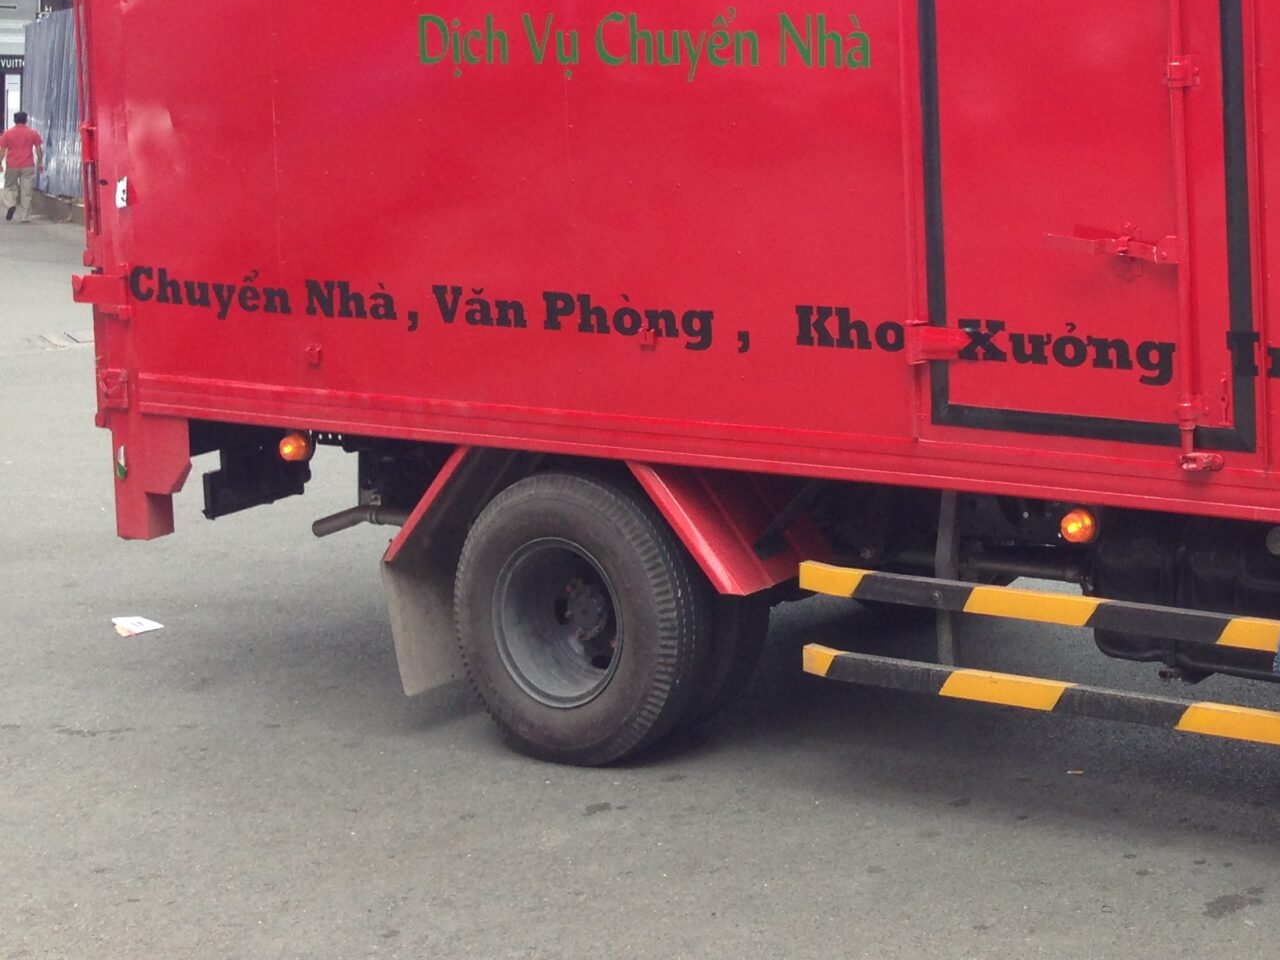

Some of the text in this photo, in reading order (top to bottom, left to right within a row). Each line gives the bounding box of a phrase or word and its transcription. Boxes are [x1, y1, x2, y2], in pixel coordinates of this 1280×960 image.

[418, 7, 872, 82] Dịch Vụ Chuyển Nhà
[129, 265, 292, 320] Chuyển
[432, 285, 528, 328] Văn
[795, 305, 905, 352] Kho
[957, 318, 1176, 386] Xưởng
